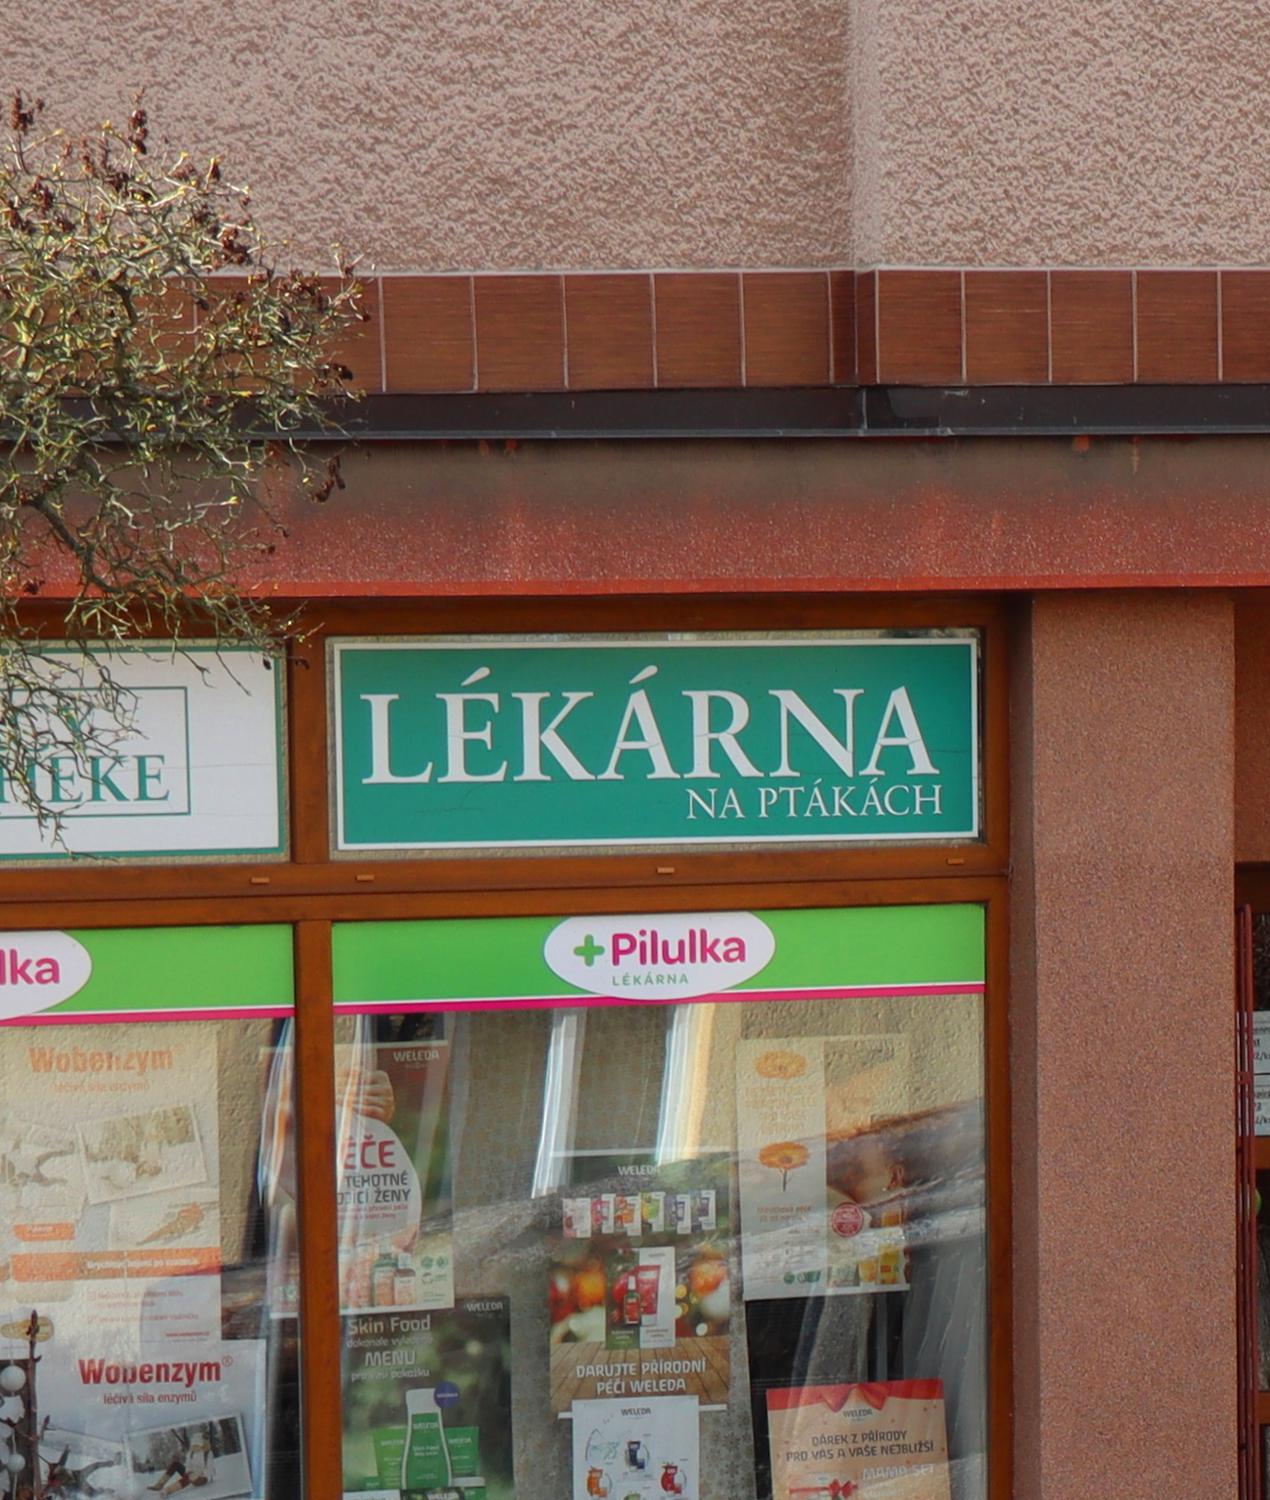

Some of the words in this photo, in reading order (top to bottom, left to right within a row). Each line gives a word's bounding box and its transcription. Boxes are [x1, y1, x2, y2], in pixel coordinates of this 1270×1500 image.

[360, 665, 940, 784] LÉKÁRNA
[686, 788, 745, 821] NA
[758, 778, 944, 819] PTÁKÁCH
[612, 928, 746, 966] Pilulka
[612, 971, 689, 987] LÉKÁRNA
[374, 1187, 412, 1203] ŽENY
[348, 1317, 384, 1335] Skin
[391, 1314, 432, 1332] Food
[365, 1350, 417, 1367] MENU
[576, 1363, 637, 1378] DARUJTE
[642, 1357, 707, 1374] PŘÍRODNÍ
[597, 1378, 625, 1394] PÉČI
[630, 1378, 687, 1393] WELEDA
[811, 1432, 848, 1447] DÁREK
[852, 1434, 859, 1444] Z
[861, 1429, 908, 1443] PŘÍRODY
[786, 1450, 808, 1462] PRO
[837, 1449, 847, 1458] A
[849, 1445, 877, 1457] VAŠE
[880, 1440, 935, 1456] NEJBLIŽŠÍ
